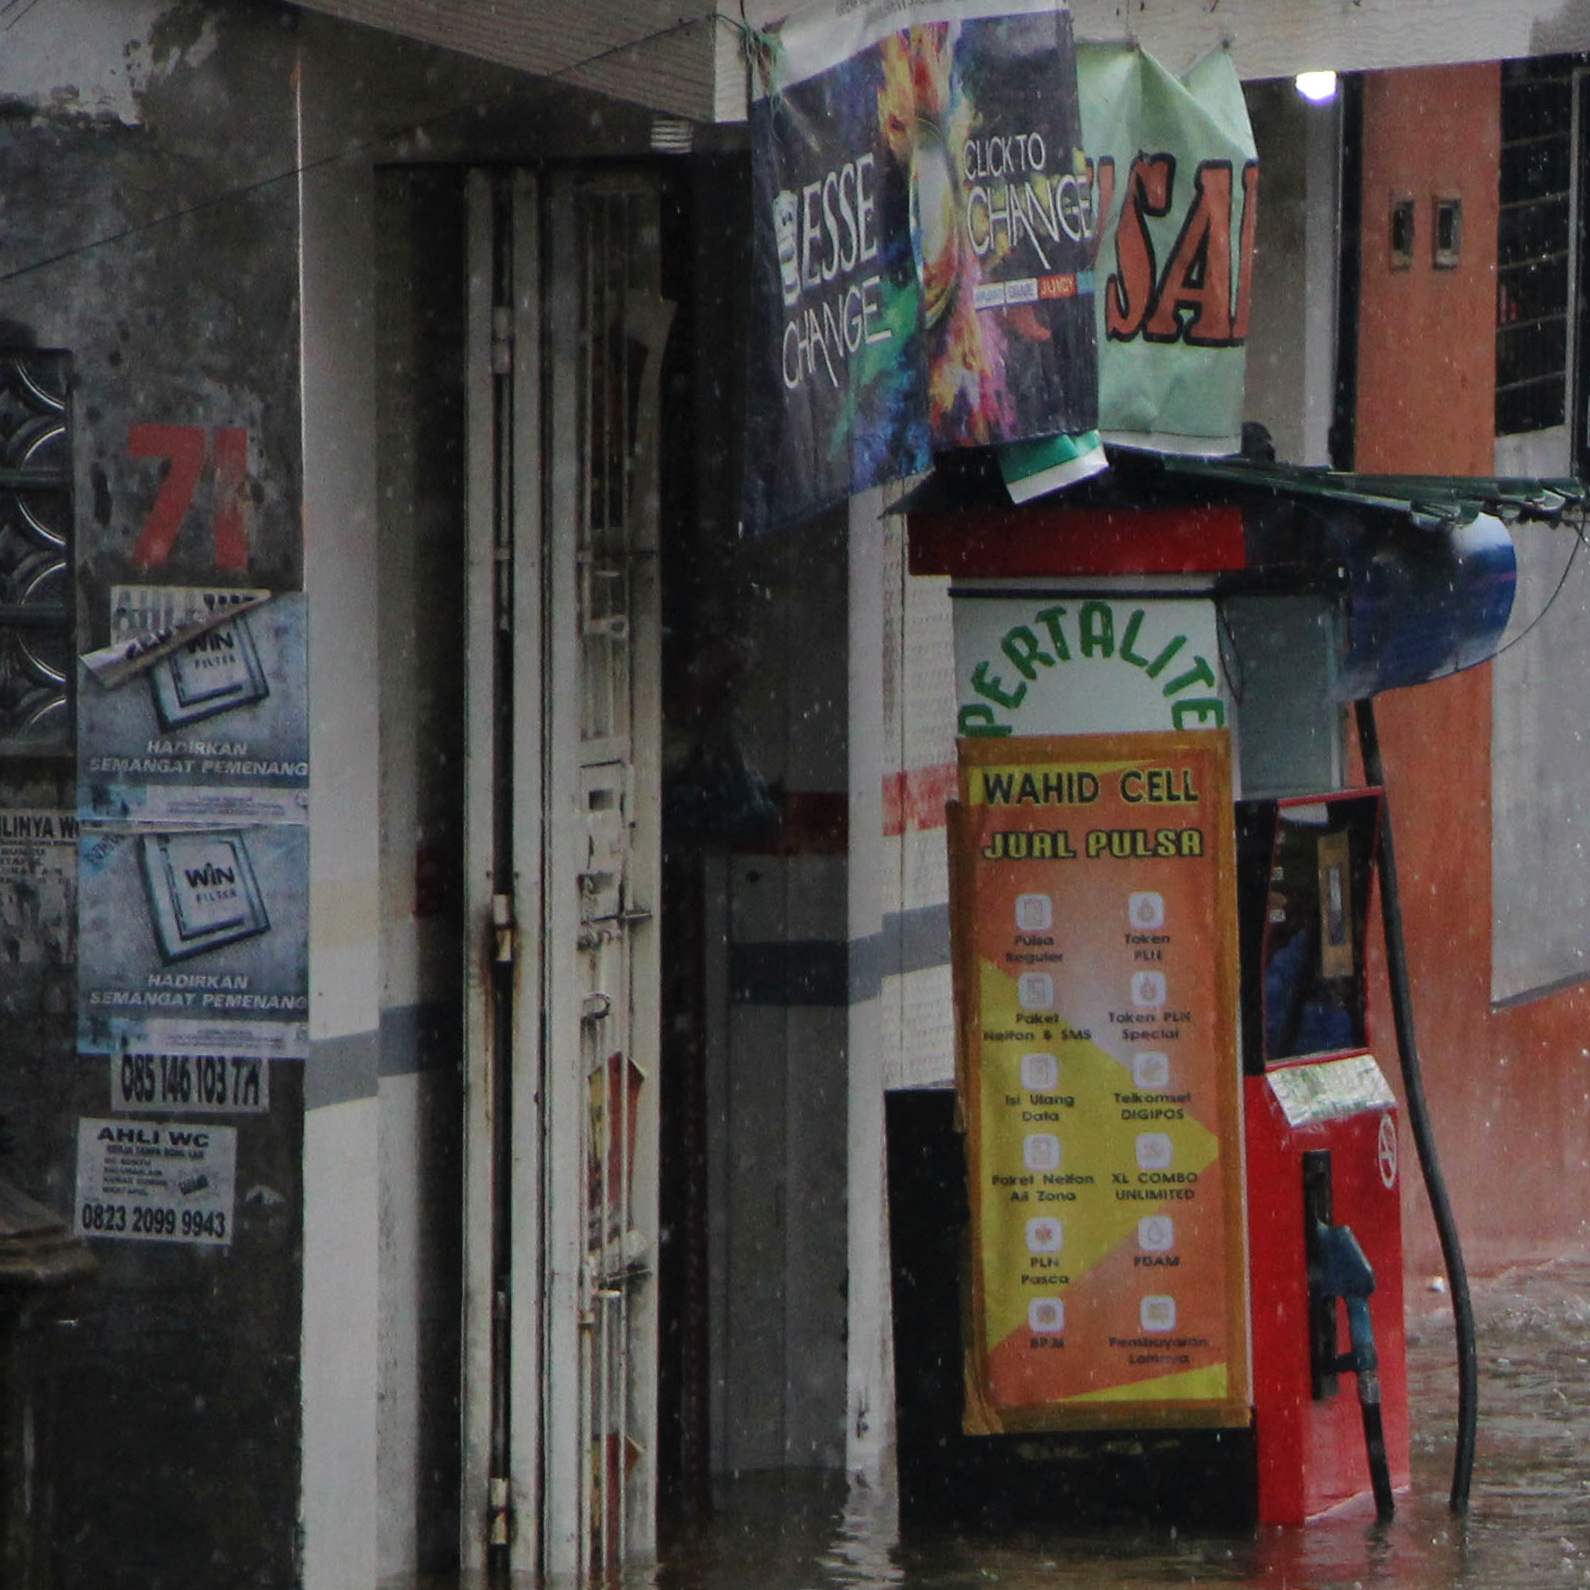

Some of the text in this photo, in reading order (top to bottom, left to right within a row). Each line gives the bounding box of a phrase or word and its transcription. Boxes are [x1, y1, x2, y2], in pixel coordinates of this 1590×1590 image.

[963, 132, 1046, 180] CLICK TO
[801, 153, 879, 293] ESSE
[966, 175, 1093, 270] CHANGE
[782, 276, 892, 389] CHANGE
[127, 423, 250, 571] 71
[957, 600, 1226, 738] PERTALITE
[89, 757, 309, 777] SEMANGAT PEMENANG
[982, 769, 1200, 805] WAHID CELL
[983, 828, 1204, 860] JUAL PULSA
[184, 861, 236, 889] WIN
[1124, 933, 1171, 945] Token
[147, 973, 250, 991] HADIRKAN
[90, 990, 194, 1007] SEMANGAT
[1108, 1012, 1156, 1024] Token
[1022, 1111, 1060, 1122] Data
[97, 1126, 209, 1148] AHLI WC
[1111, 1172, 1199, 1184] XL COMBO
[1115, 1189, 1196, 1201] UNLIMITED
[82, 1203, 226, 1239] 0823 2099 9943
